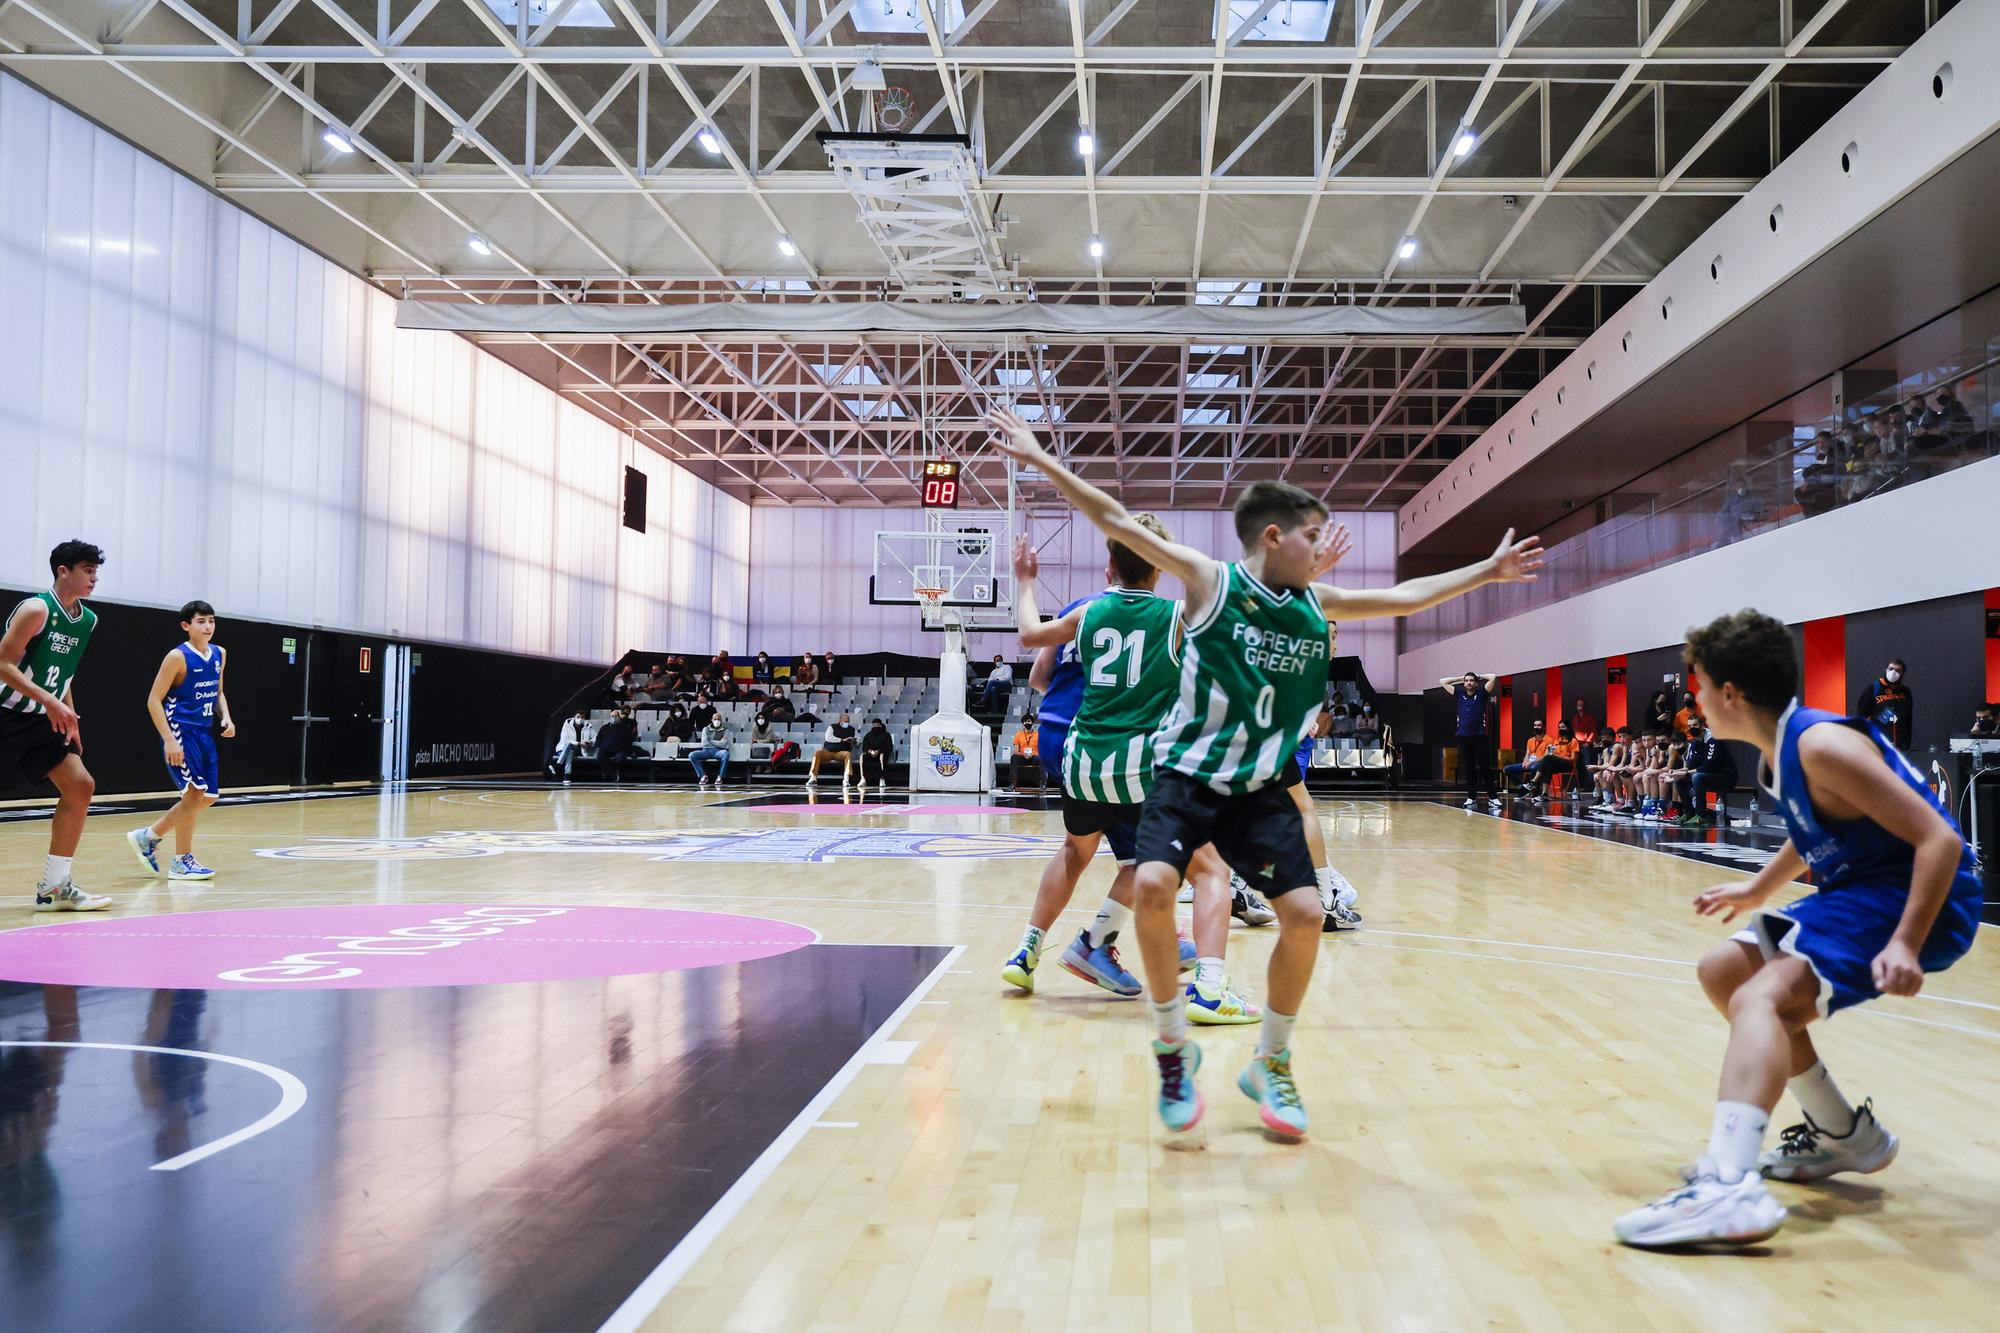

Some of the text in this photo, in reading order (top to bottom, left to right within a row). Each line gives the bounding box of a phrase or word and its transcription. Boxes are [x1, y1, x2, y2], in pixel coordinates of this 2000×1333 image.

[925, 481, 955, 504] 08
[47, 631, 79, 646] FOREVER
[50, 642, 71, 654] GREEN
[1232, 622, 1325, 659] FOREVER
[1089, 627, 1146, 688] 21
[1245, 646, 1306, 675] GREEN
[44, 665, 60, 687] 12
[202, 702, 214, 716] 31
[1254, 684, 1275, 729] 0
[415, 743, 495, 767] pista NACHO RODILLA
[217, 907, 577, 982] endesa
